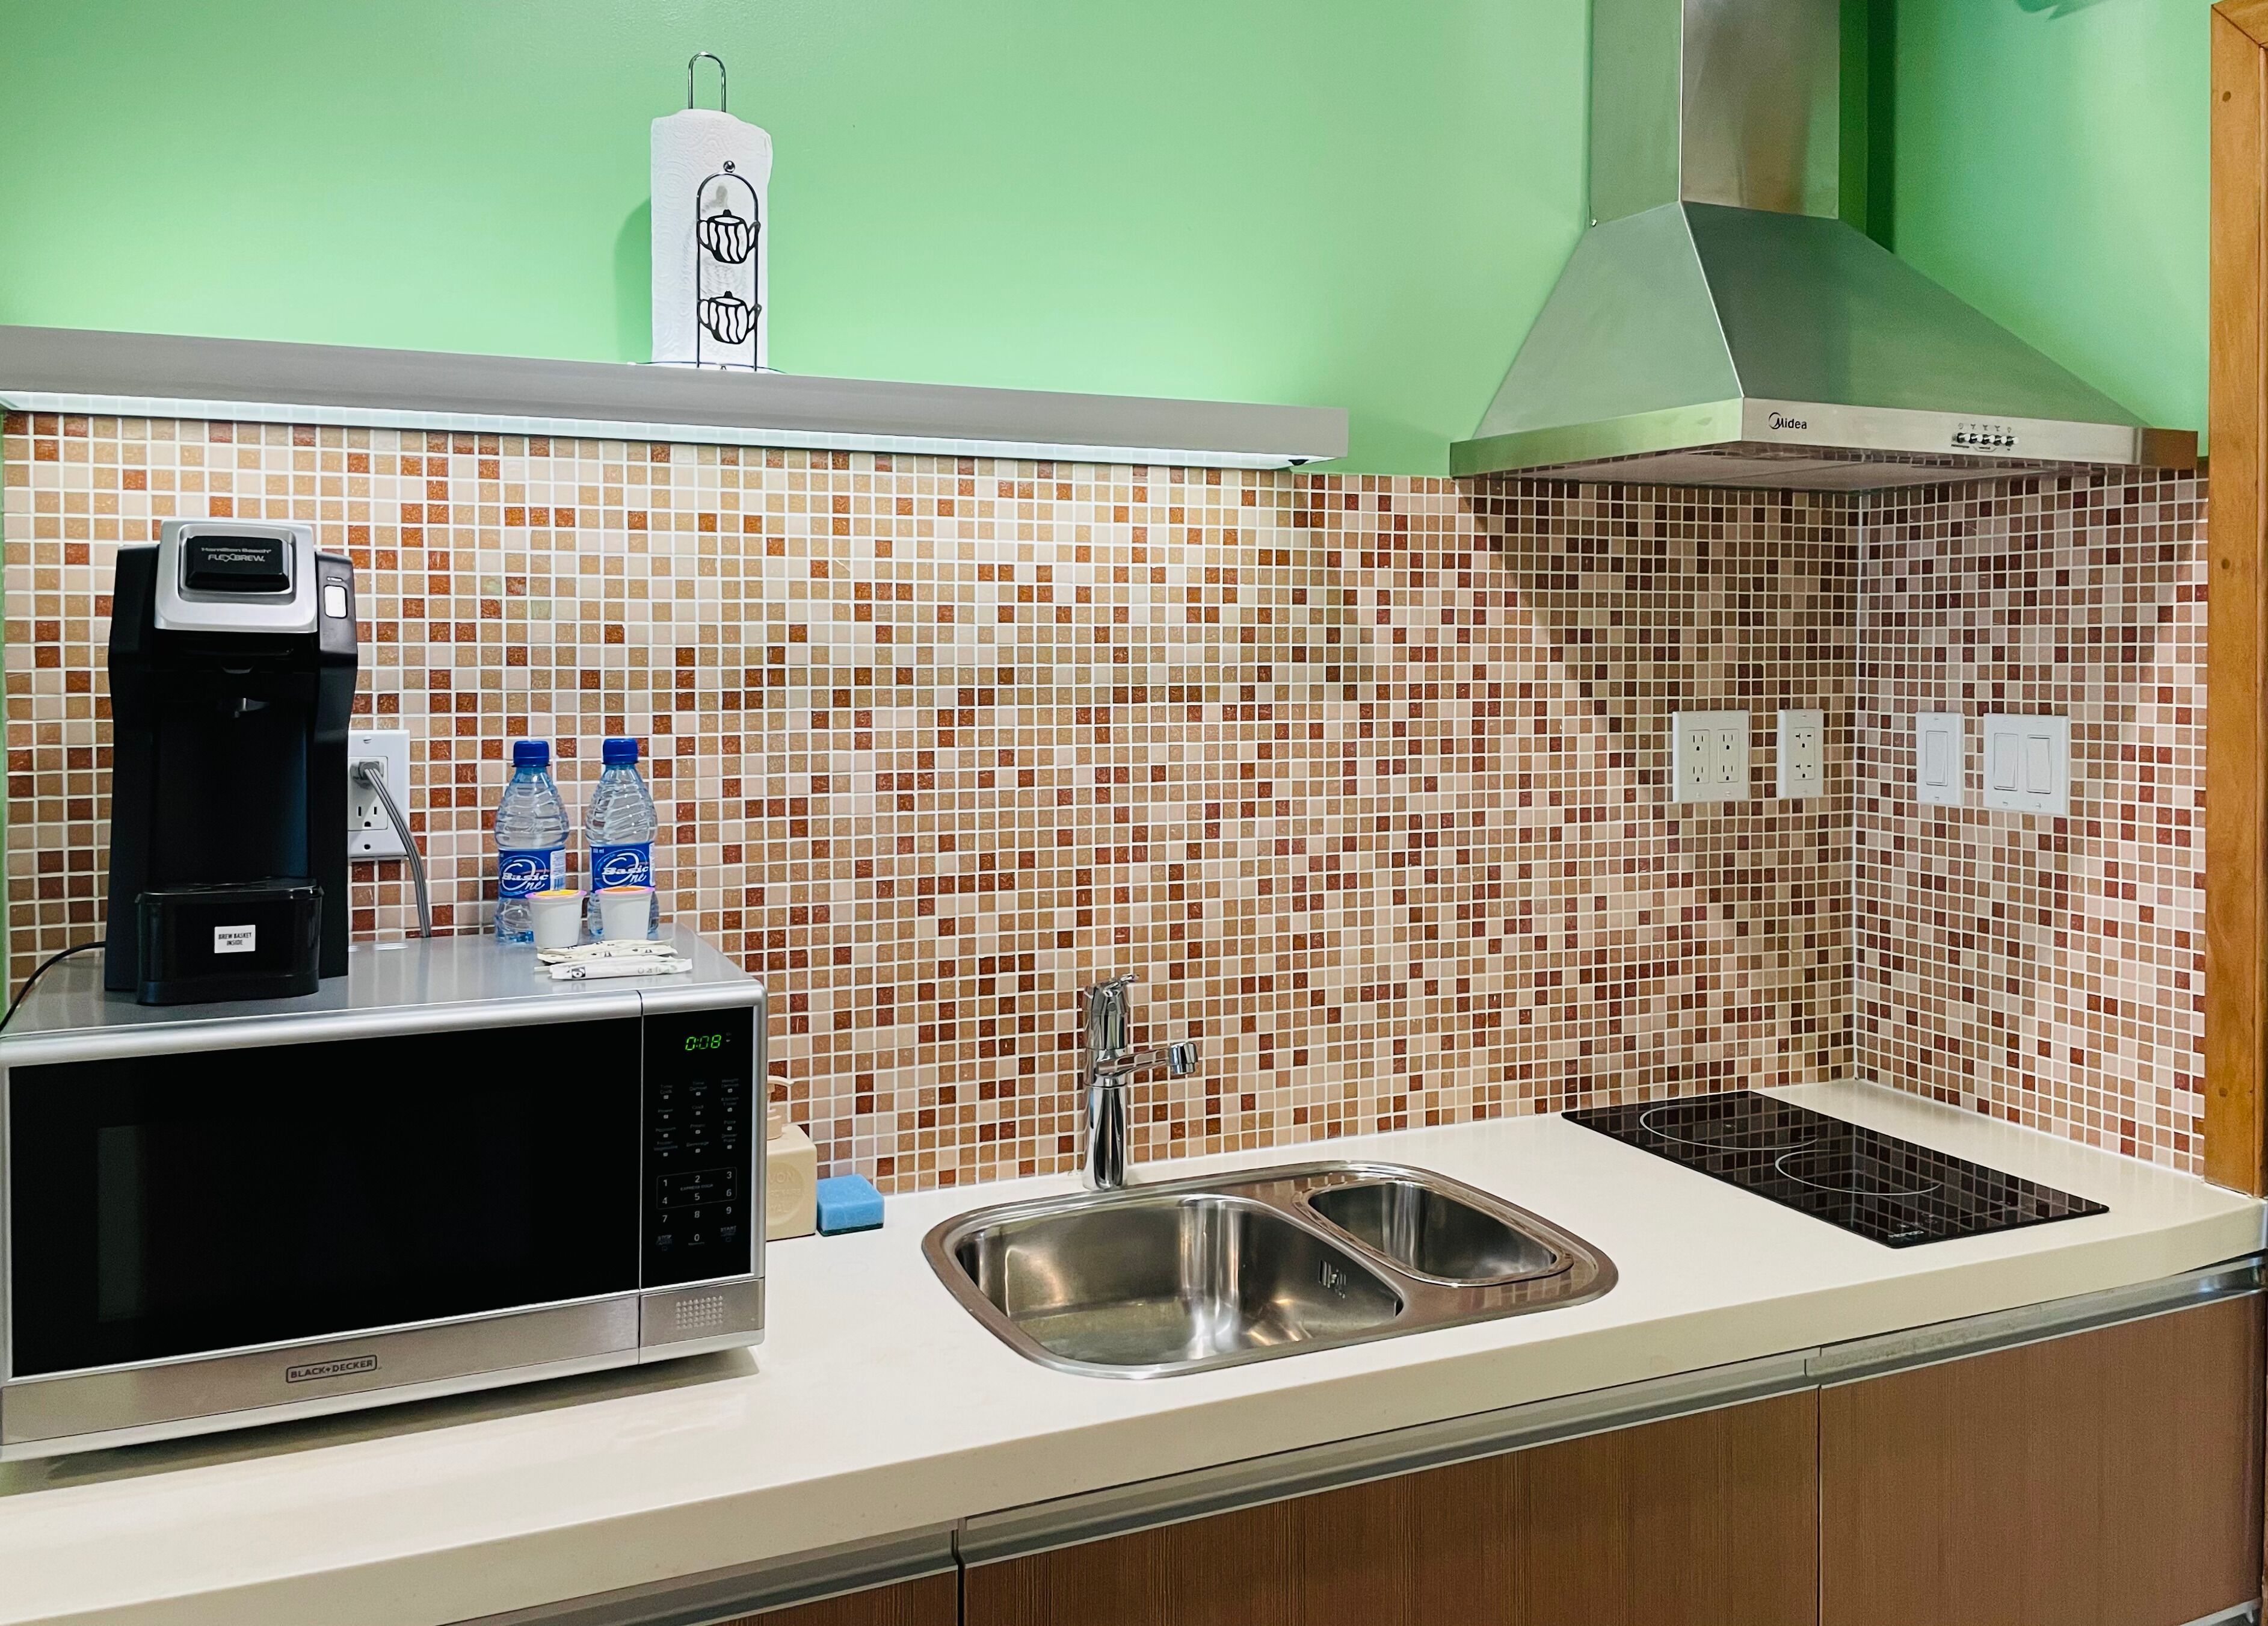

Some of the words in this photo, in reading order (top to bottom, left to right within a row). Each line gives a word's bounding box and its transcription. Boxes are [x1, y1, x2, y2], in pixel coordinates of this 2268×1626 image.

[1768, 412, 1807, 430] Midea
[602, 865, 649, 876] Basic
[501, 872, 549, 881] Basic
[685, 1034, 722, 1051] 0:08
[694, 1175, 700, 1183] 2
[726, 1189, 732, 1197] 6
[662, 1196, 668, 1205] 4
[694, 1210, 700, 1219] 8
[726, 1206, 732, 1214] 9
[662, 1214, 668, 1223] 7
[291, 1359, 374, 1378] BLACK+DECKER
